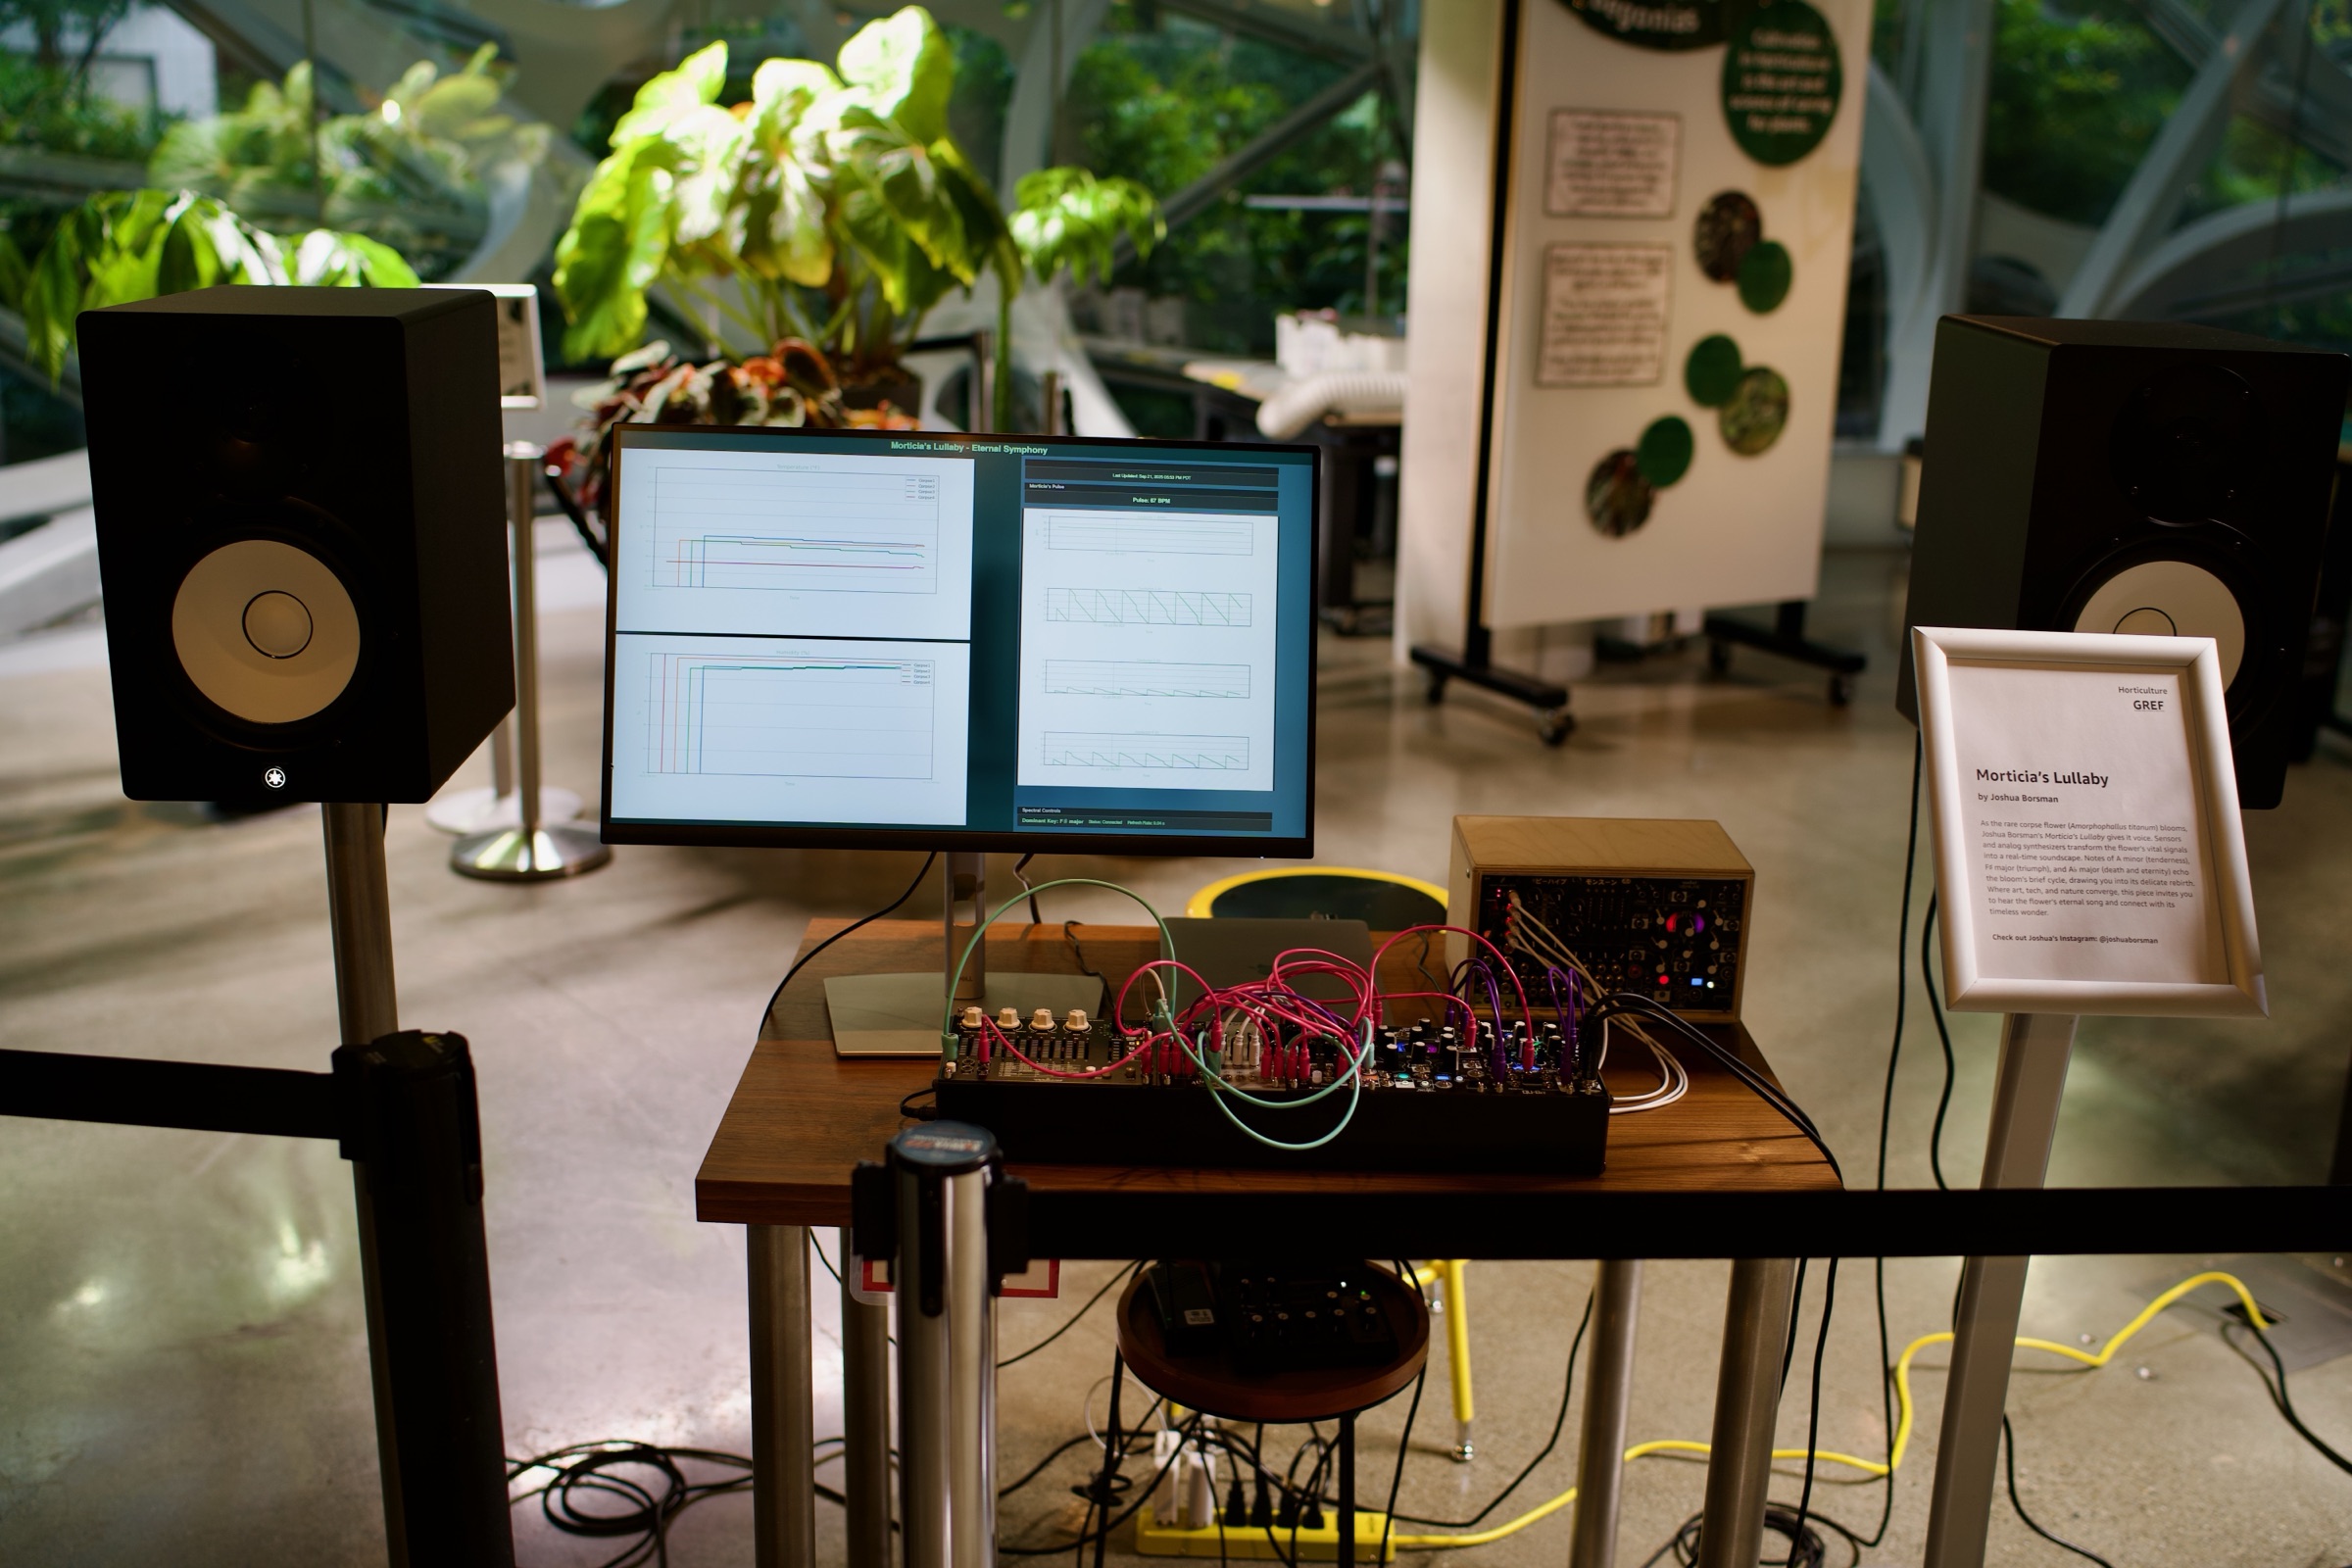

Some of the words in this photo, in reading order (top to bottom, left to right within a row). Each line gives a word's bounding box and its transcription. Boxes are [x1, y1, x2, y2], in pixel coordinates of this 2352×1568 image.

[891, 442, 931, 450] Morticia's
[934, 443, 964, 453] Lullaby
[972, 444, 1001, 452] Eternal
[1004, 445, 1048, 456] Symphony
[2133, 700, 2164, 711] GREF
[1977, 769, 2049, 784] Morticia's
[2054, 772, 2108, 788] Lullaby
[1978, 793, 1988, 802] by
[2022, 795, 2058, 803] Borsman
[2107, 834, 2125, 842] gives
[1998, 842, 2022, 851] analog
[2141, 869, 2171, 877] eternity)
[2069, 877, 2098, 885] drawing
[2100, 936, 2158, 944] @joshuaborsman
